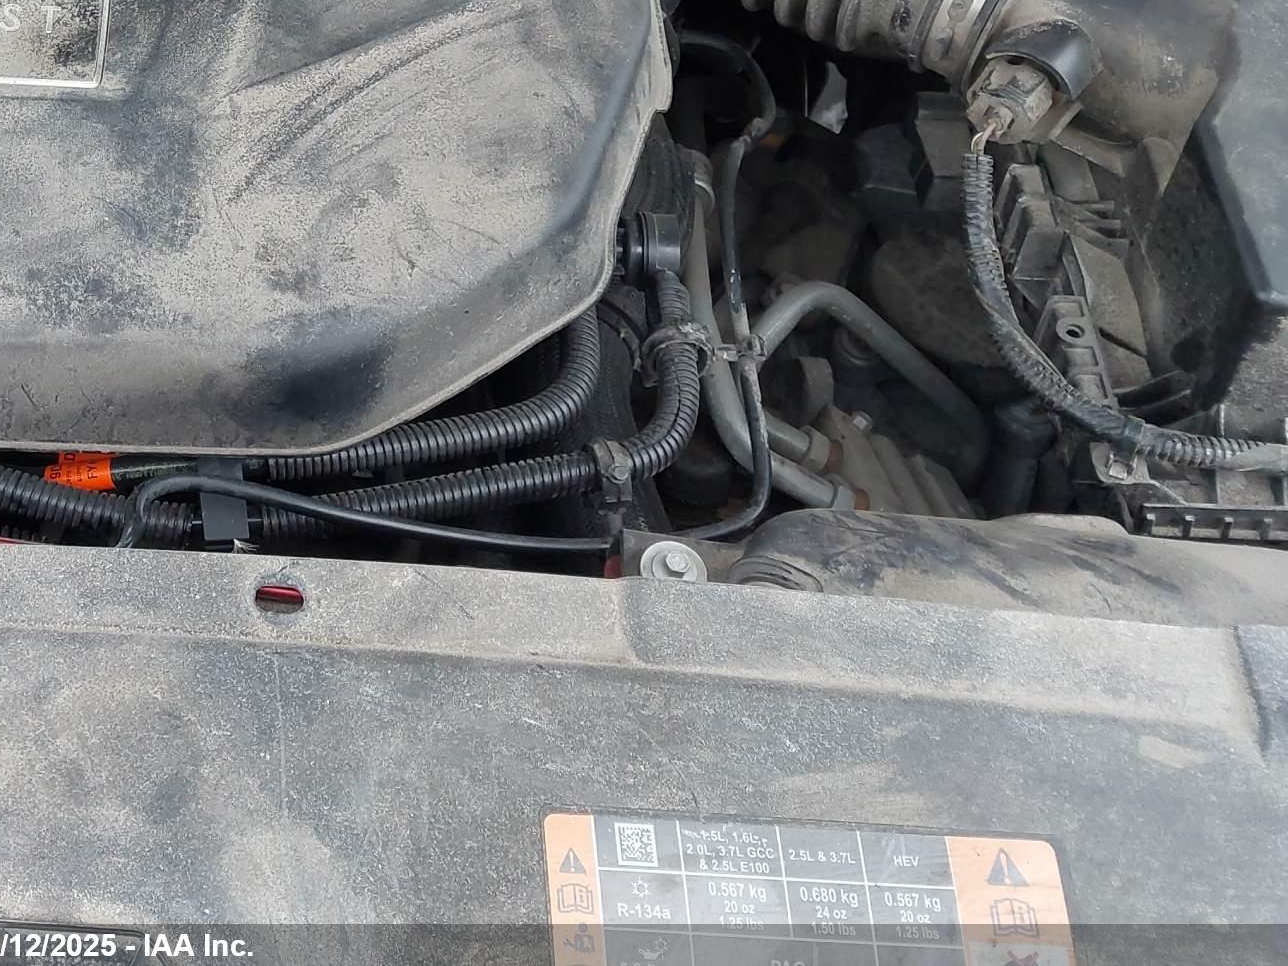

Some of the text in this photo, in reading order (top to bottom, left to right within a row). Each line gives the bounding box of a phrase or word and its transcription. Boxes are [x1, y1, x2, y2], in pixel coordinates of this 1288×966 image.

[686, 843, 775, 859] 2.0L, 3.7L GCC
[788, 849, 856, 864] 2.5L & 3.7L
[699, 858, 770, 874] & 2.5L E100
[893, 855, 920, 867] HEV
[708, 881, 767, 902] 0.567 kg
[799, 886, 859, 907] 0.680 kg
[724, 901, 755, 915] 20 oz
[884, 892, 942, 912] 0.567 kg
[617, 902, 672, 920] R-134a
[815, 905, 848, 920] 24 oz
[900, 910, 932, 924] 20 oz
[719, 916, 765, 931] 1.25 lbs
[811, 921, 857, 936] 1.50 lbs
[895, 925, 940, 940] 1.25 lbs
